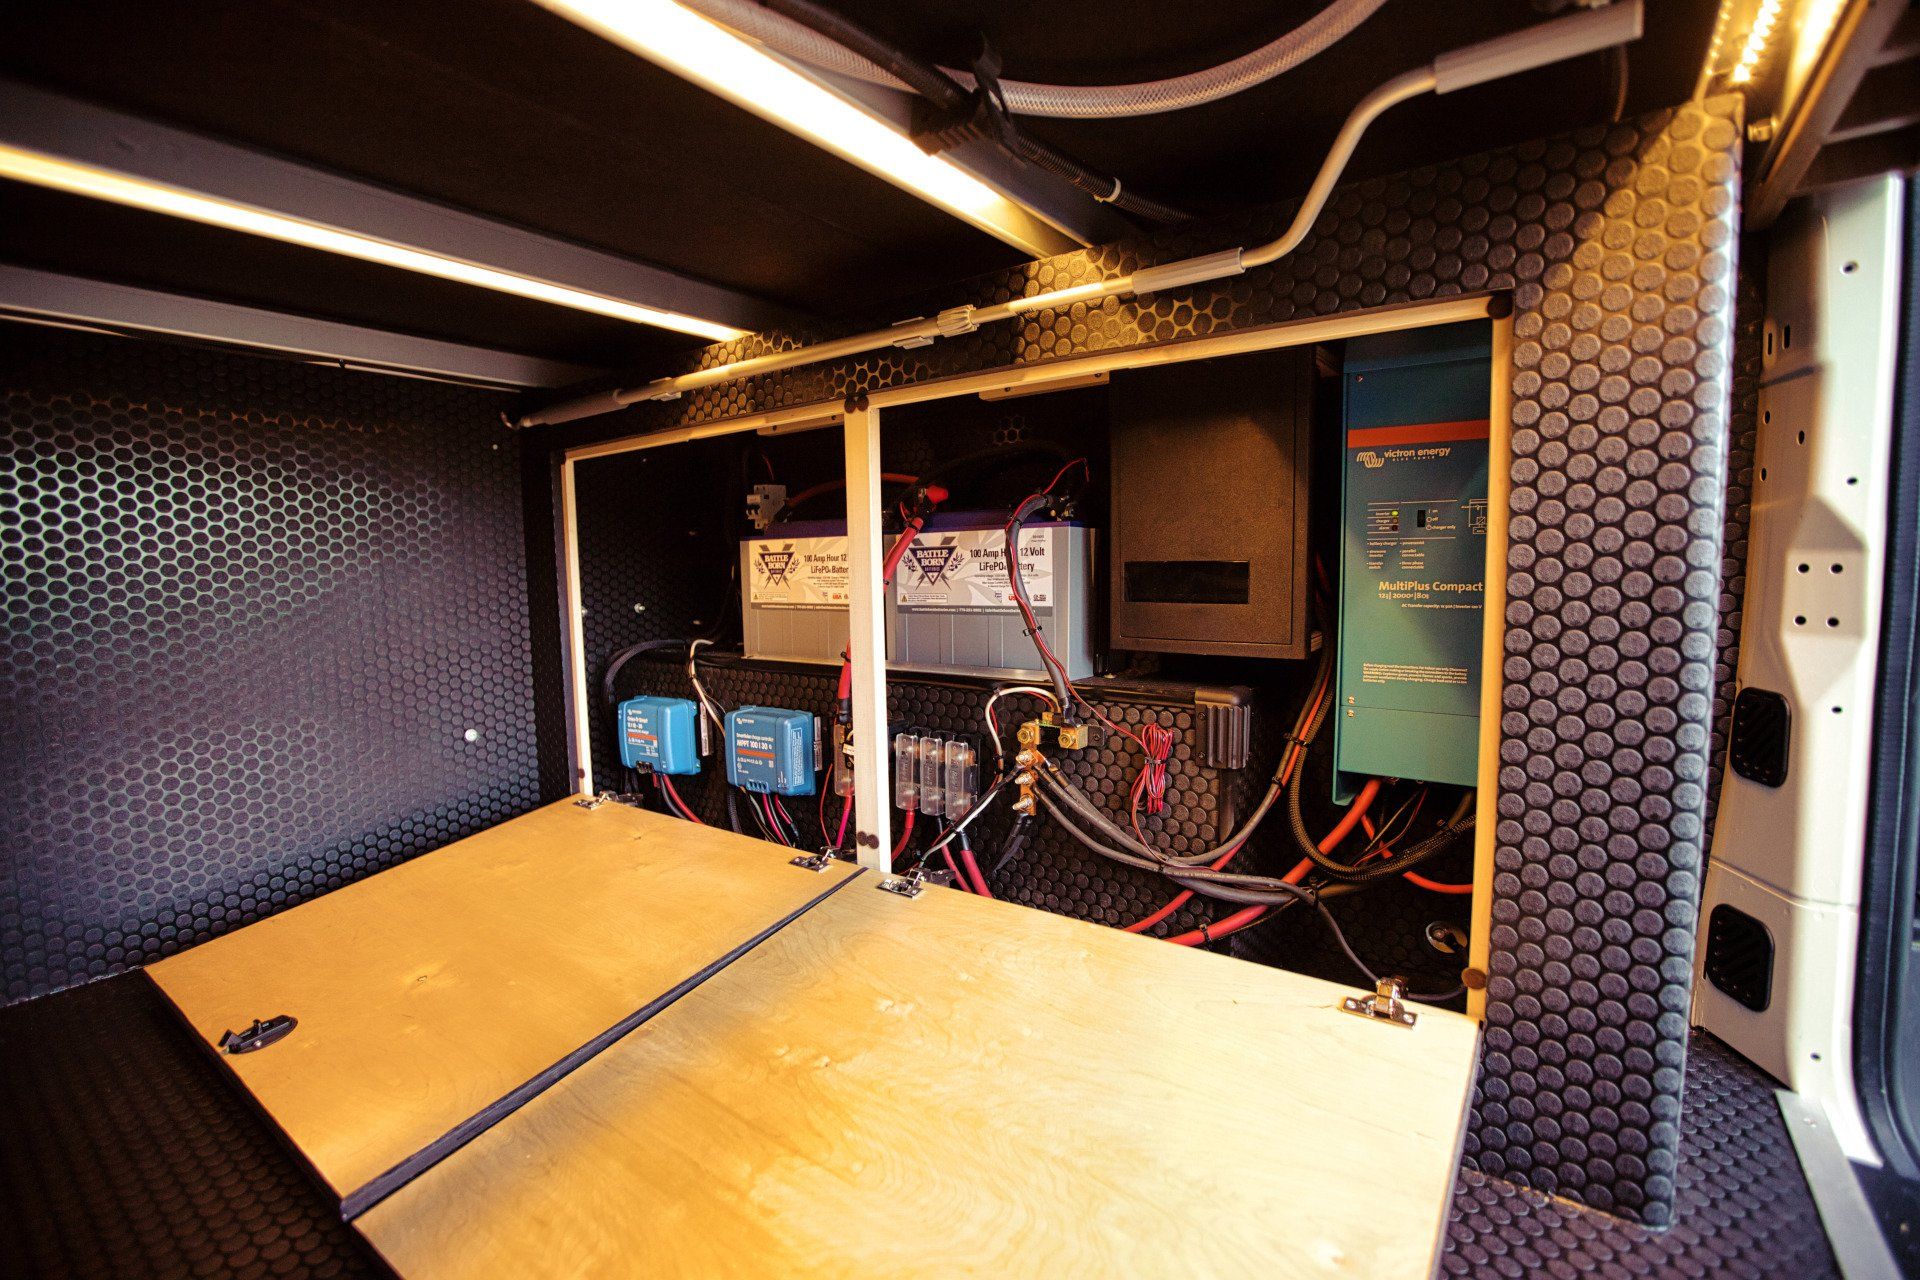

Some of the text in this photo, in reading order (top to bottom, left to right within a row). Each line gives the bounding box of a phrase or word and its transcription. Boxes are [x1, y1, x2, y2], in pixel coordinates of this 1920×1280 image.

[1384, 447, 1451, 458] victron energy
[916, 549, 949, 558] BATTLE
[970, 549, 982, 558] 100
[982, 548, 999, 560] Amp
[1020, 547, 1029, 557] 12
[1029, 546, 1045, 556] Volt
[764, 554, 789, 562] BATTLE
[804, 553, 847, 564] 100 Amp Hour 12
[921, 558, 945, 567] BORN
[767, 561, 786, 570] BORN
[831, 565, 849, 574] Batter
[1378, 581, 1484, 593] MultiPlus Compact
